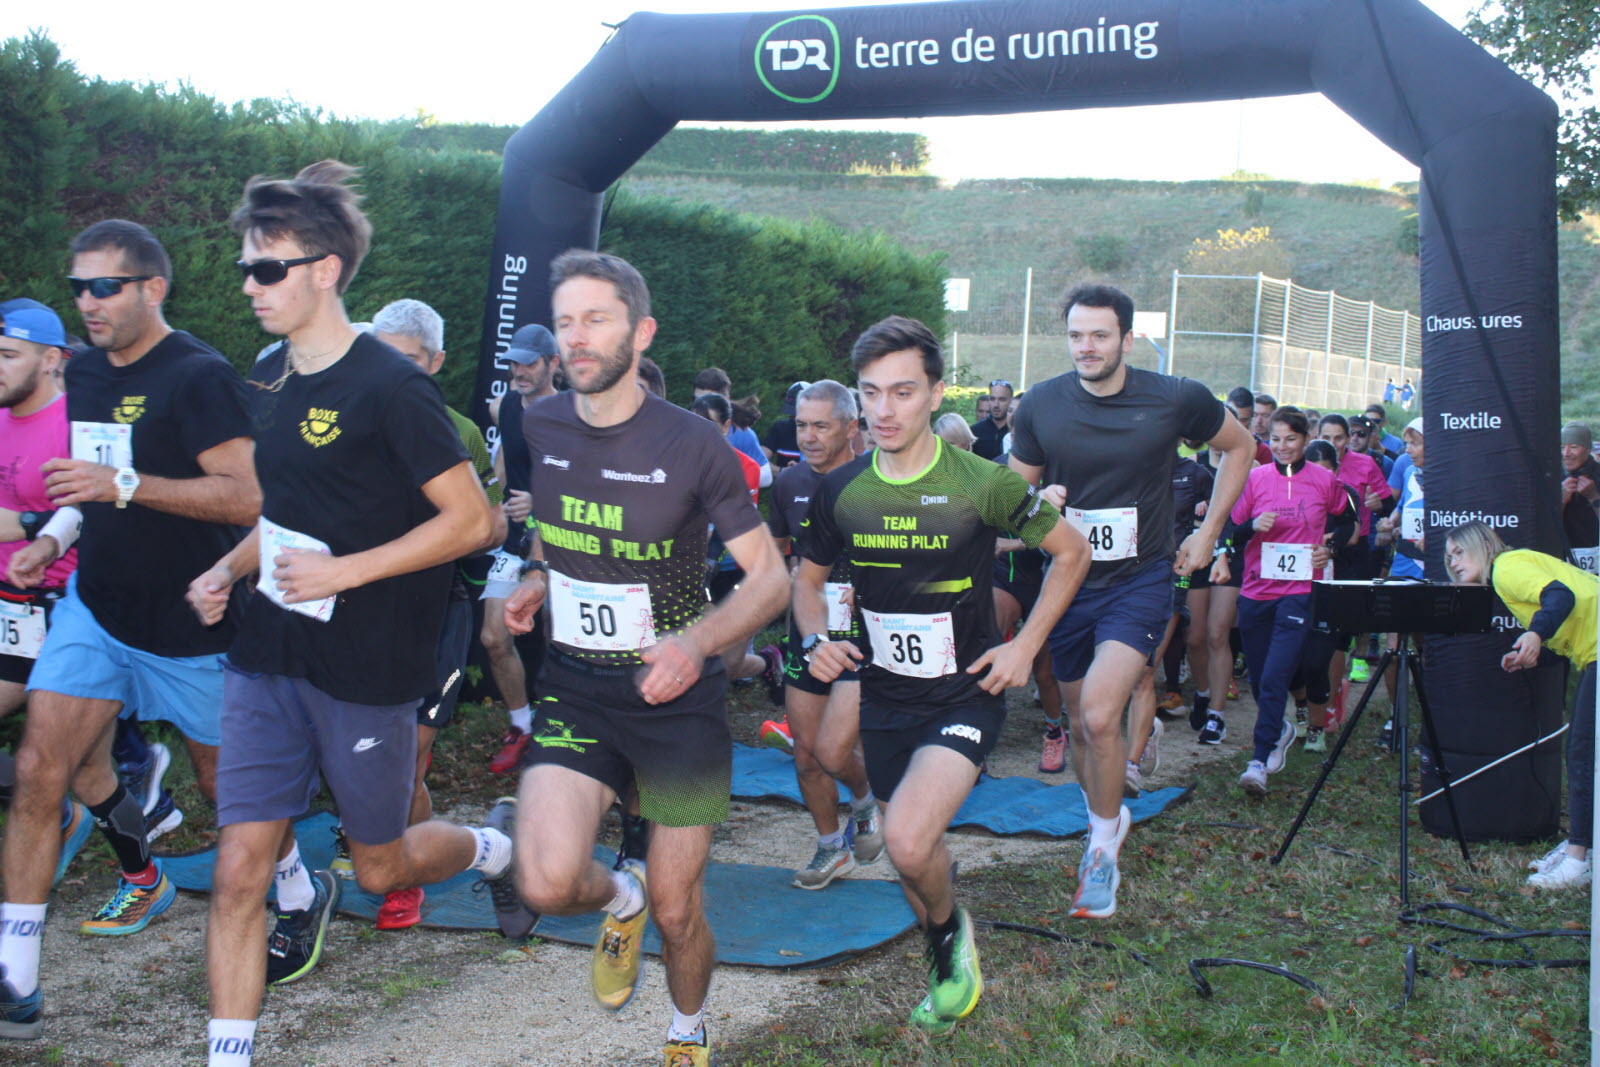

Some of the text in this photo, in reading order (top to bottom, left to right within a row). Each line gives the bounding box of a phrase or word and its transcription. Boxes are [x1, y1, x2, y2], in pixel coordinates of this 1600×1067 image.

[855, 17, 1159, 69] terre de running
[766, 38, 832, 72] TDR
[494, 254, 527, 370] running
[308, 407, 340, 423] BOXE
[1440, 411, 1502, 430] Textile
[298, 420, 342, 448] FRANÇAISE
[601, 468, 651, 483] Wanteez
[560, 494, 624, 531] TEAM
[882, 515, 917, 531] TEAM
[1414, 517, 1425, 533] 3
[534, 519, 674, 561] UNNING PILAT
[853, 534, 949, 549] RUNNING PILAT
[1088, 524, 1114, 551] 48
[1277, 554, 1296, 573] 42
[1580, 556, 1595, 570] 62
[579, 602, 617, 637] 50
[932, 616, 948, 624] 2024
[889, 633, 923, 666] 36
